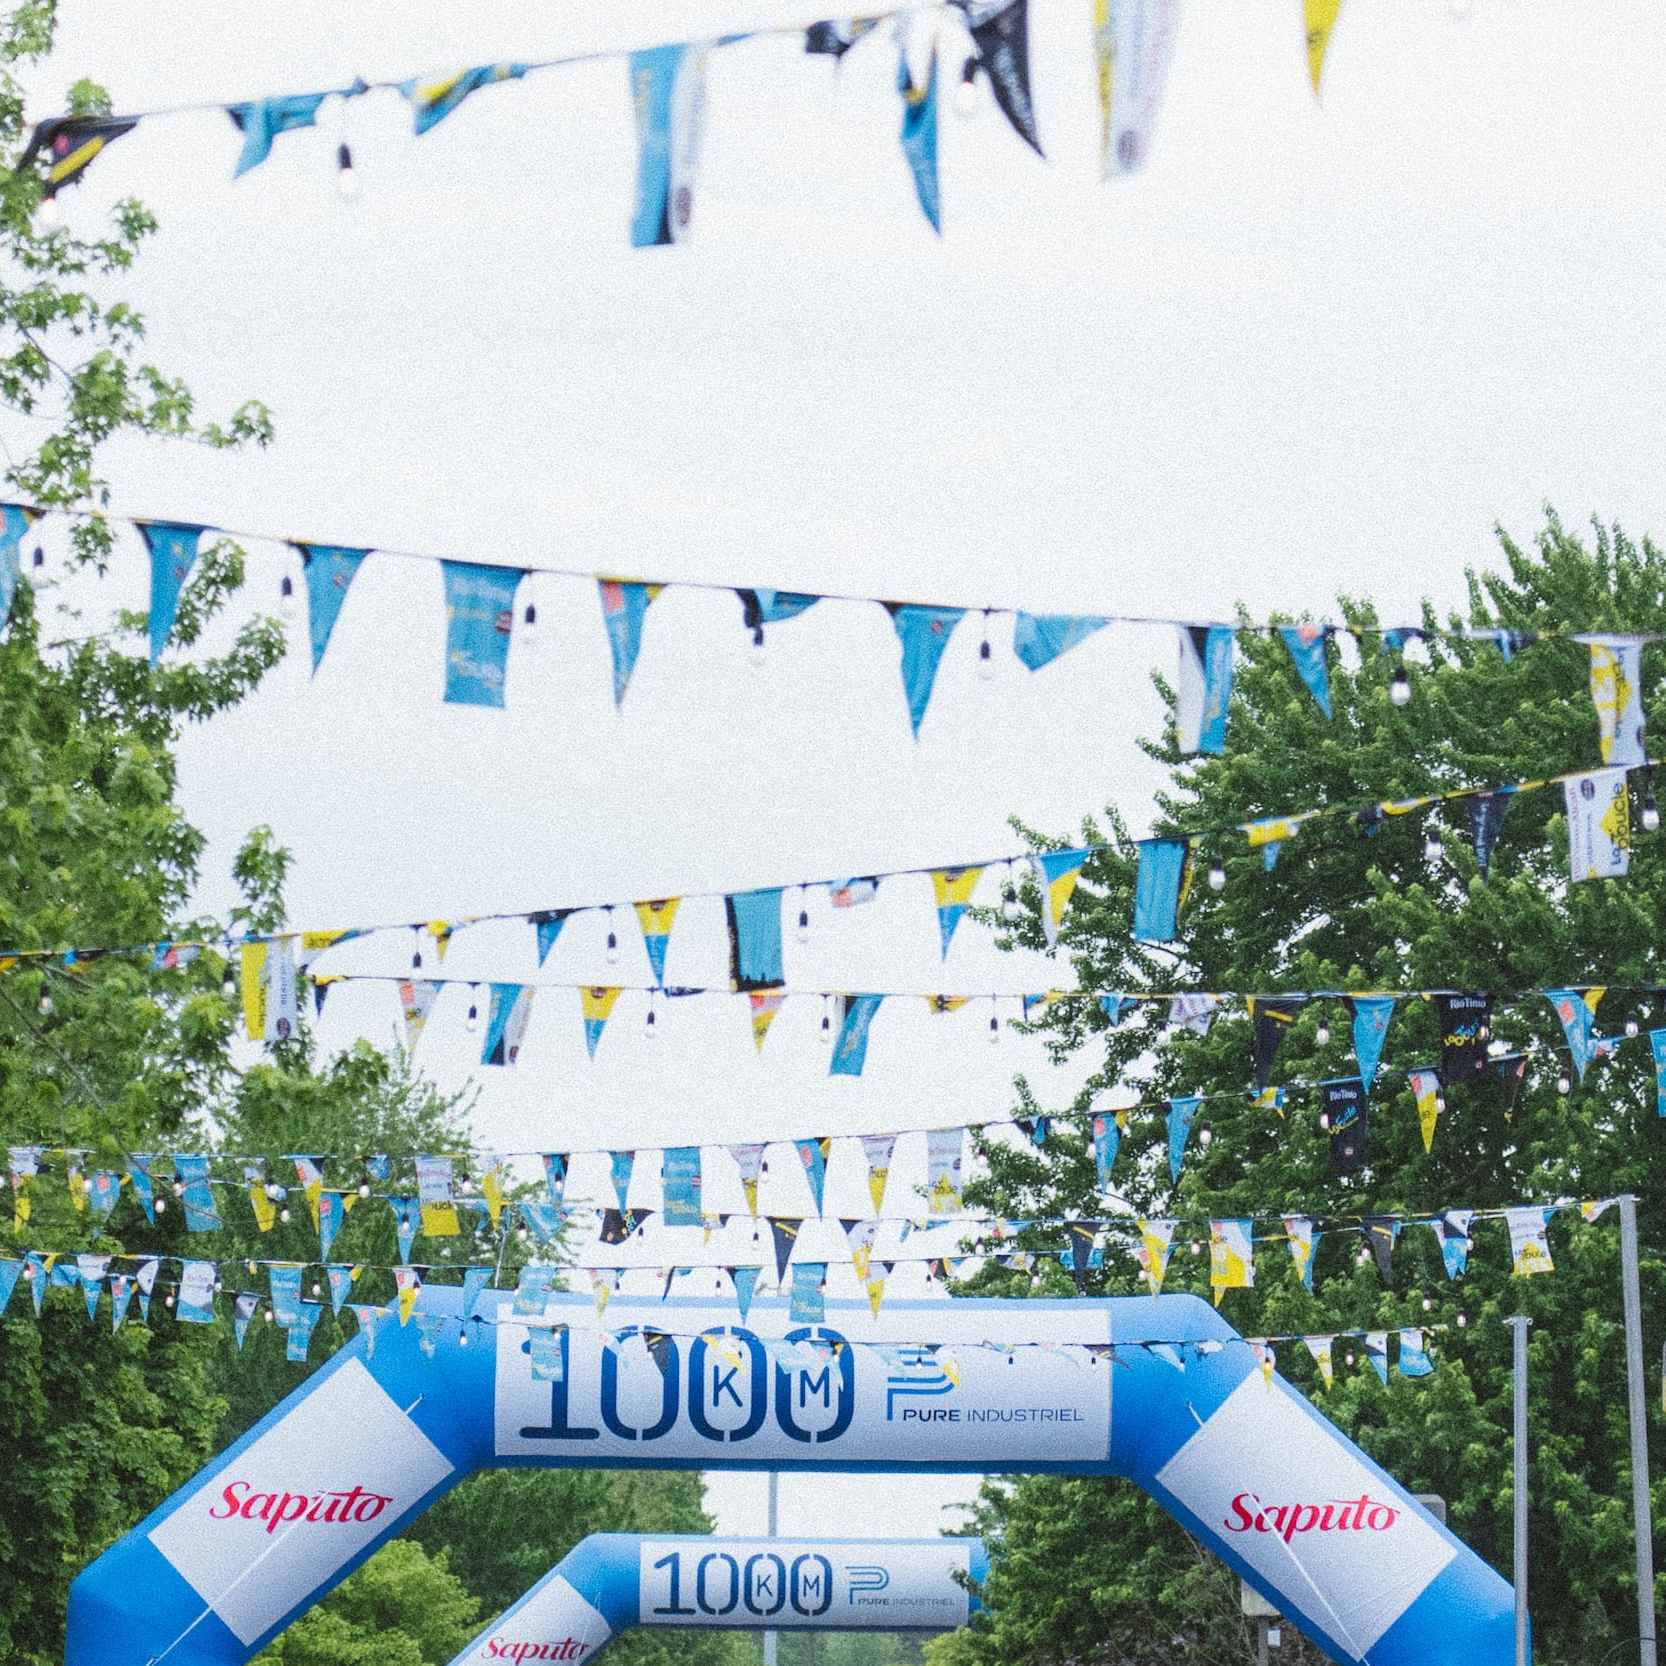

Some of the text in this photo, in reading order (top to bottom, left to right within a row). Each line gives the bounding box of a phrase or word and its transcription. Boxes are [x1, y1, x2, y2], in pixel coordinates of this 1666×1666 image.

[519, 1322, 855, 1443] 1000
[902, 1408, 1085, 1422] PURE INDUSTRIEL
[209, 1480, 394, 1534] Saputo
[1224, 1492, 1401, 1544] Saputo
[652, 1552, 833, 1617] 1000
[857, 1598, 890, 1606] PURE
